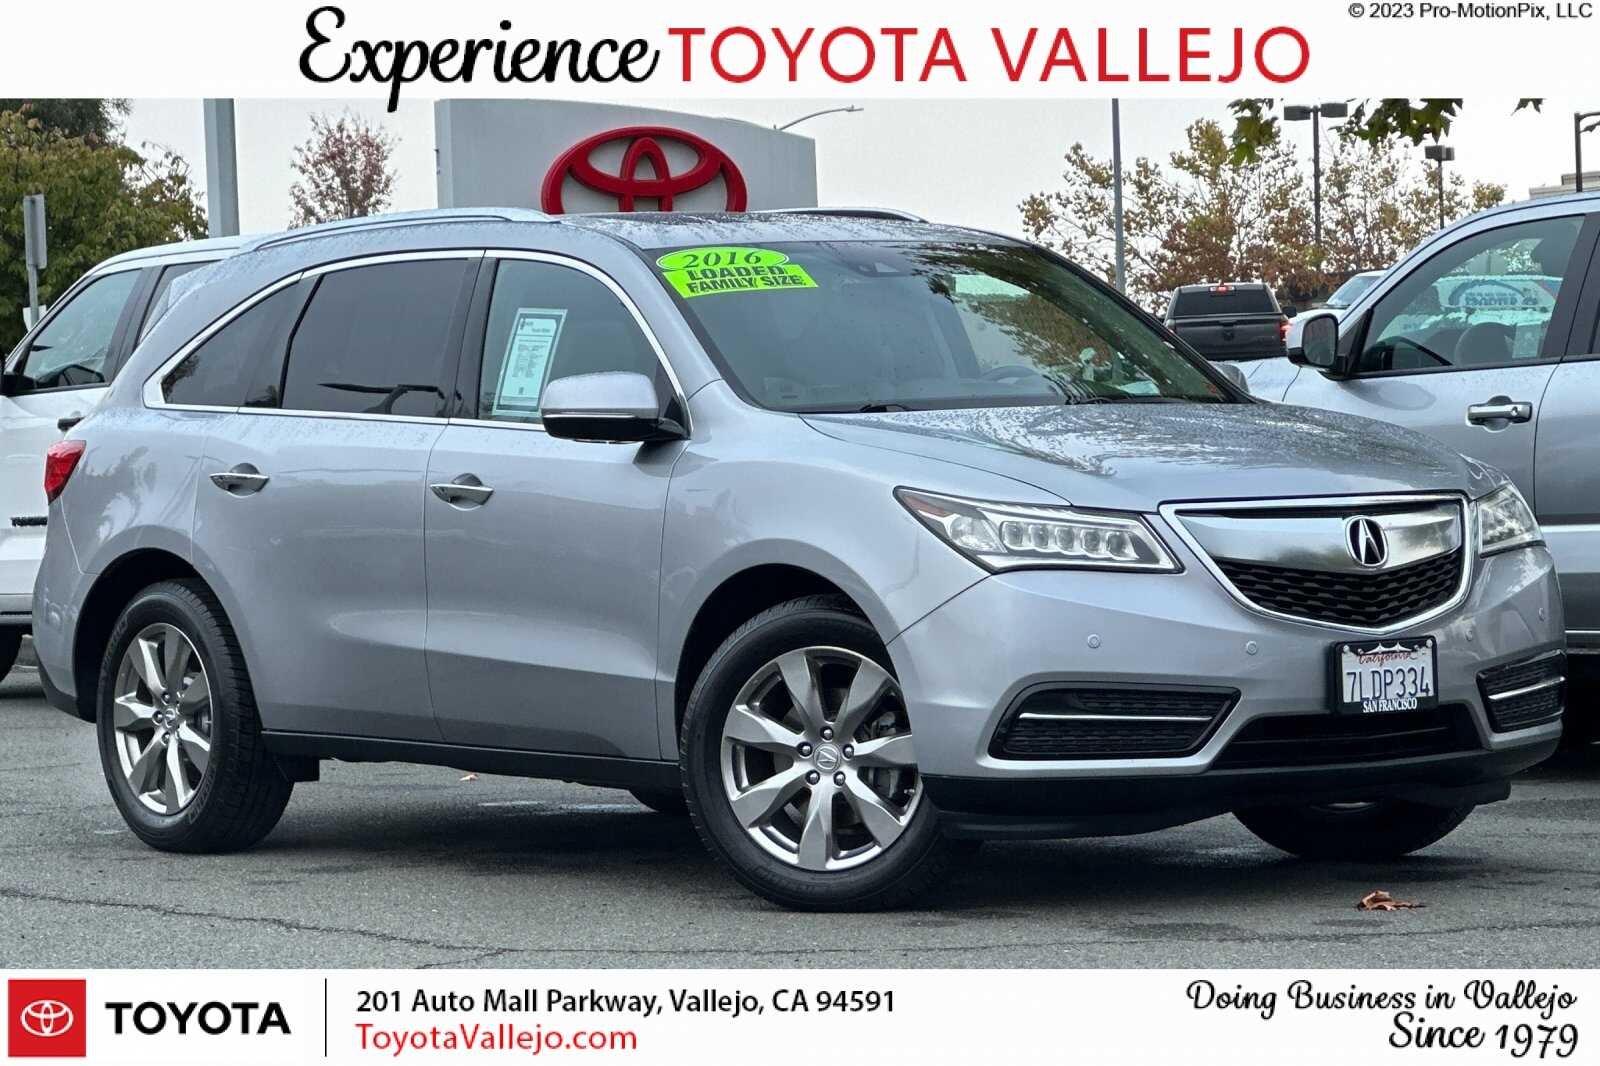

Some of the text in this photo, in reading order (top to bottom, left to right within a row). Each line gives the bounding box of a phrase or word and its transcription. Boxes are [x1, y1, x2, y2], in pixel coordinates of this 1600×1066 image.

[683, 251, 762, 269] 2016
[686, 265, 785, 281] LOADED
[686, 274, 804, 294] FAMILY SIZE
[1358, 652, 1412, 666] California
[1346, 666, 1431, 702] 7LDP334
[1363, 698, 1417, 713] SAN FRANCISCO
